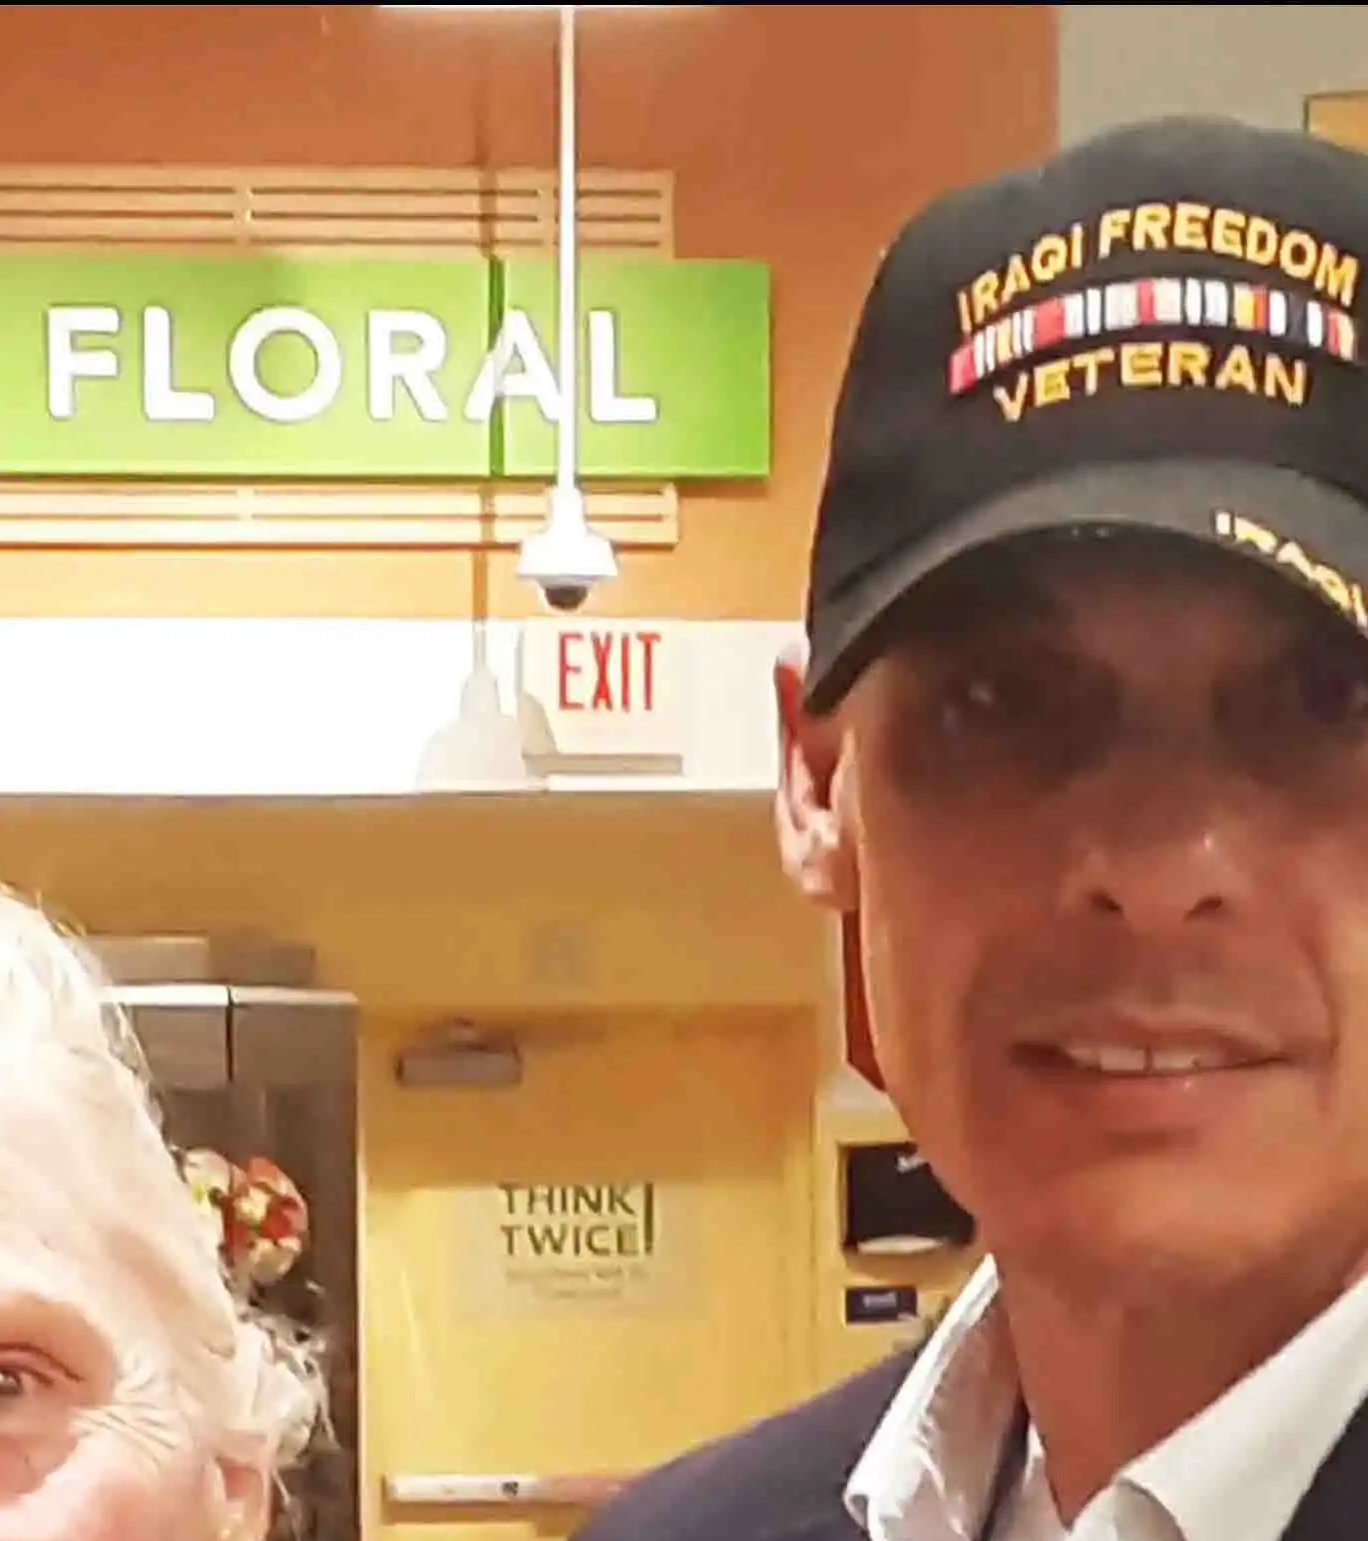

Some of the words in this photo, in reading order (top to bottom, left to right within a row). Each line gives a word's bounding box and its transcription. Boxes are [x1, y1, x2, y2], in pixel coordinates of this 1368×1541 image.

[957, 223, 1084, 334] IRAQI
[1098, 202, 1359, 307] FREEDOM
[46, 306, 660, 424] FLORAL
[993, 341, 1309, 423] VETERAN
[557, 632, 662, 712] EXIT
[496, 1181, 637, 1217] THINK
